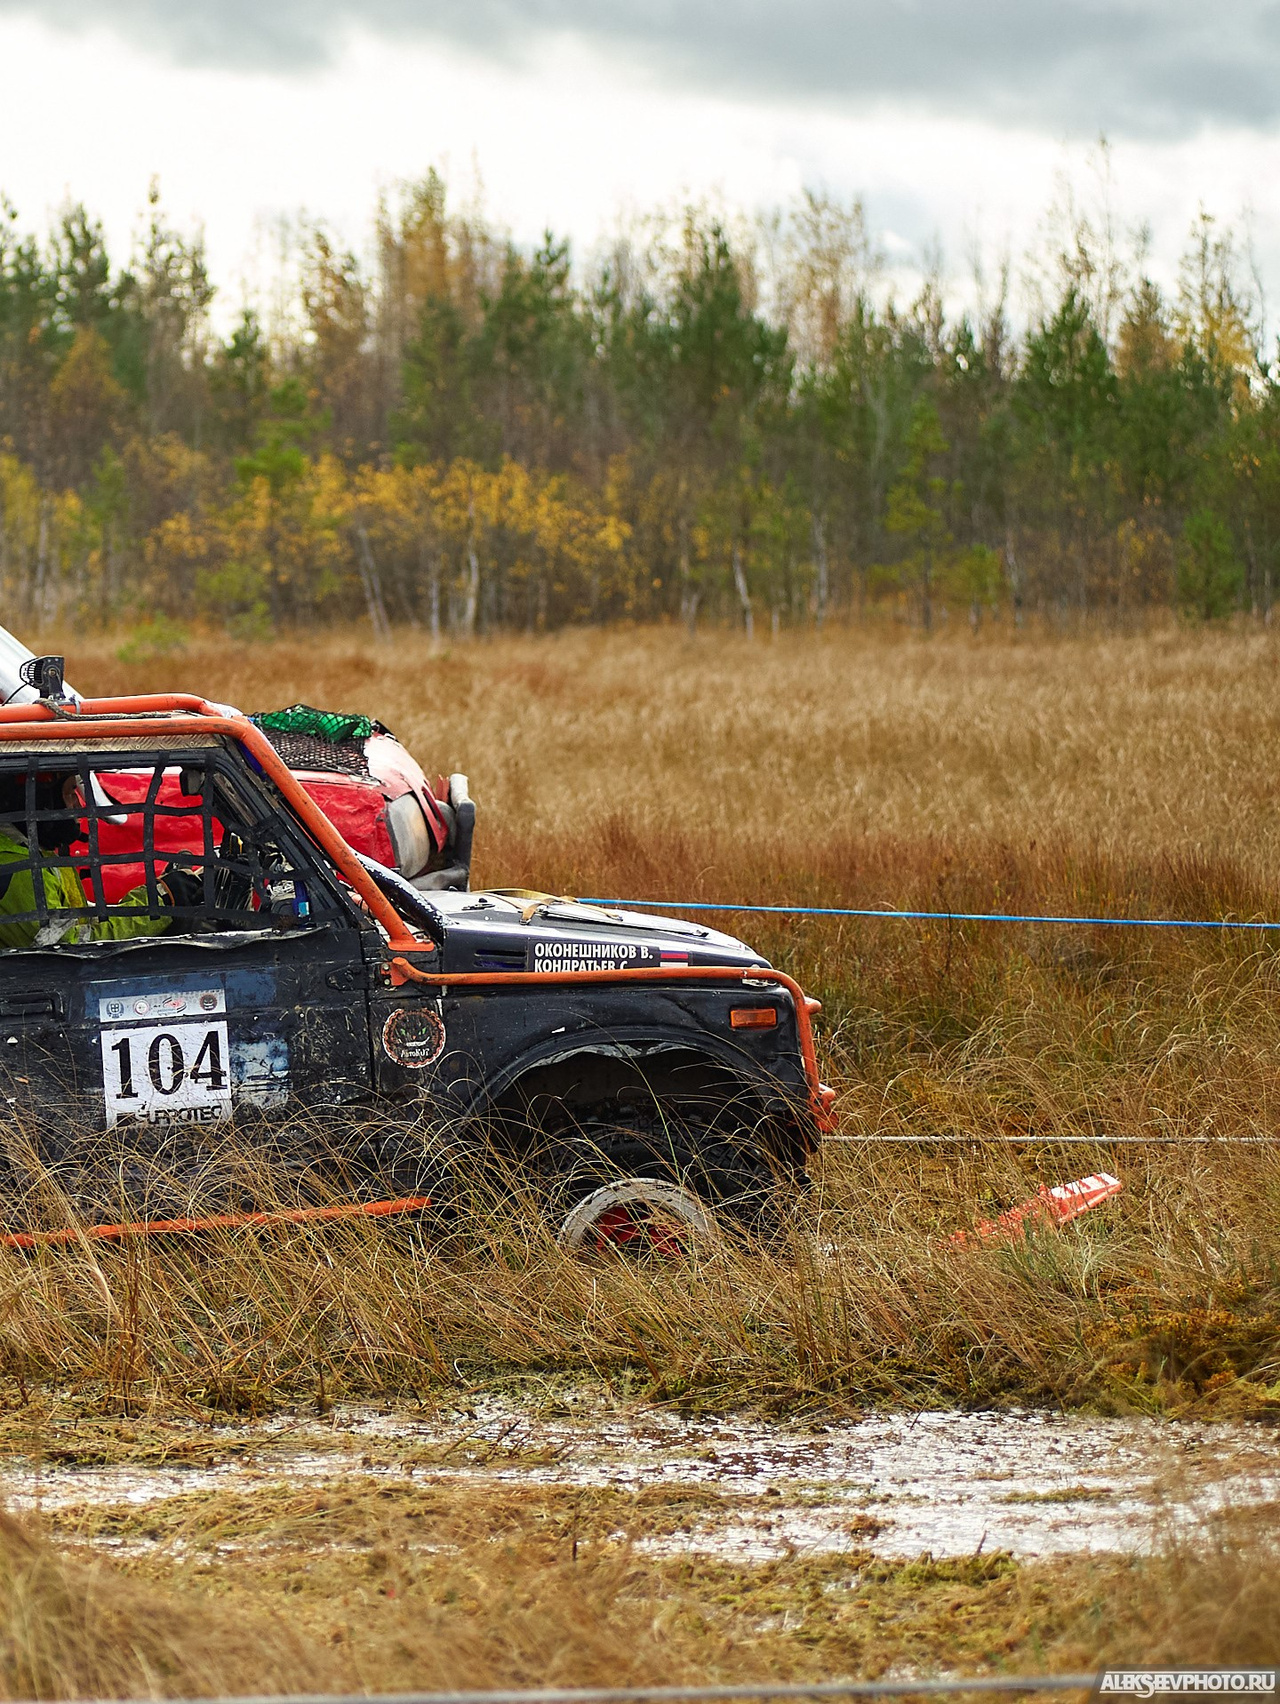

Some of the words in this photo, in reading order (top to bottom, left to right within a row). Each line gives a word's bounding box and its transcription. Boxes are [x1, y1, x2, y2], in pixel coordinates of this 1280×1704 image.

[534, 943, 637, 960] ОКОНЕШНИКОВ
[640, 946, 654, 960] В.
[534, 960, 616, 973] КОНДРАТЬЕВ
[111, 1030, 228, 1100] 104
